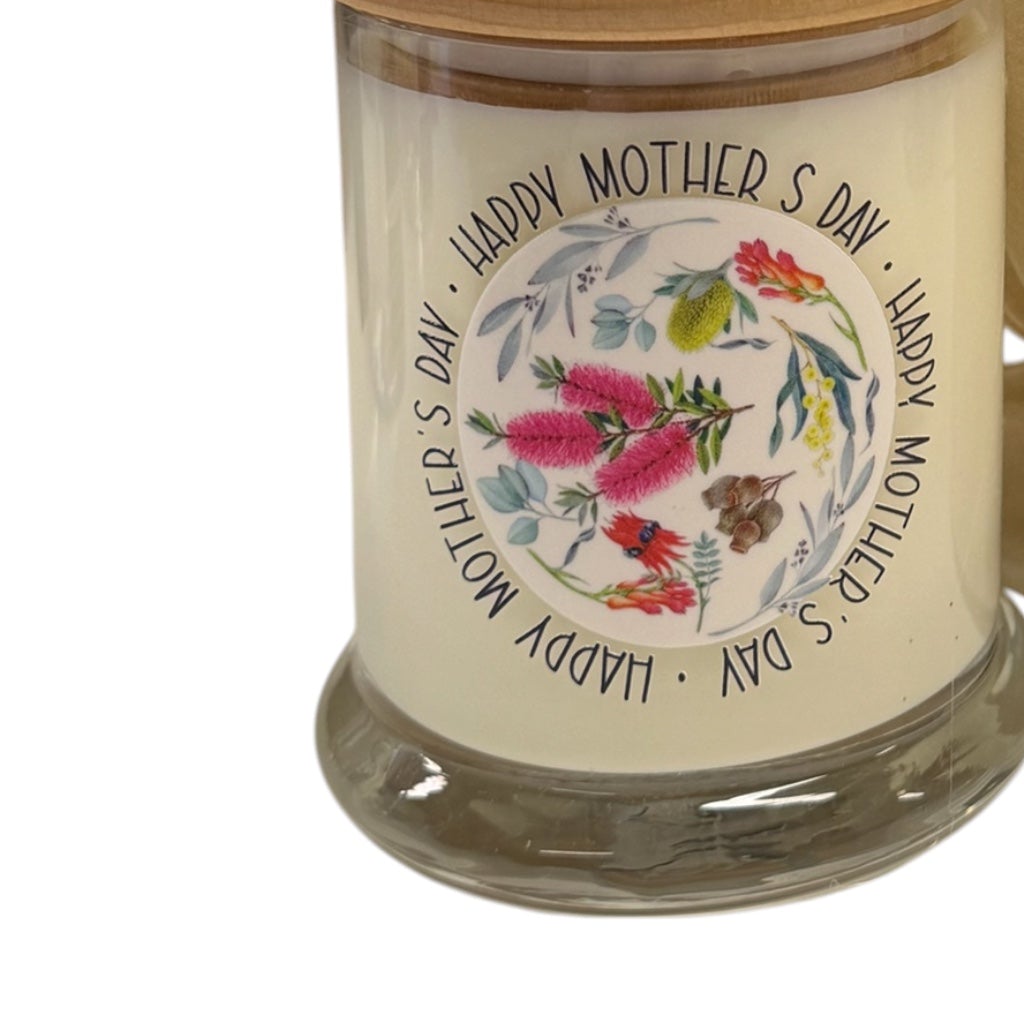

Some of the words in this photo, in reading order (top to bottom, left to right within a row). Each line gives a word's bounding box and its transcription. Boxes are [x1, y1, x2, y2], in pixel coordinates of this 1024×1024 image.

[449, 165, 564, 275] HAPPY
[817, 182, 890, 256] DAY
[414, 302, 460, 385] DAY
[885, 278, 936, 407] HAPPY
[414, 400, 519, 619] MOTHER'S
[798, 436, 930, 644] MOTHER'S
[515, 615, 654, 704] HAPPY
[721, 628, 792, 698] DAY
